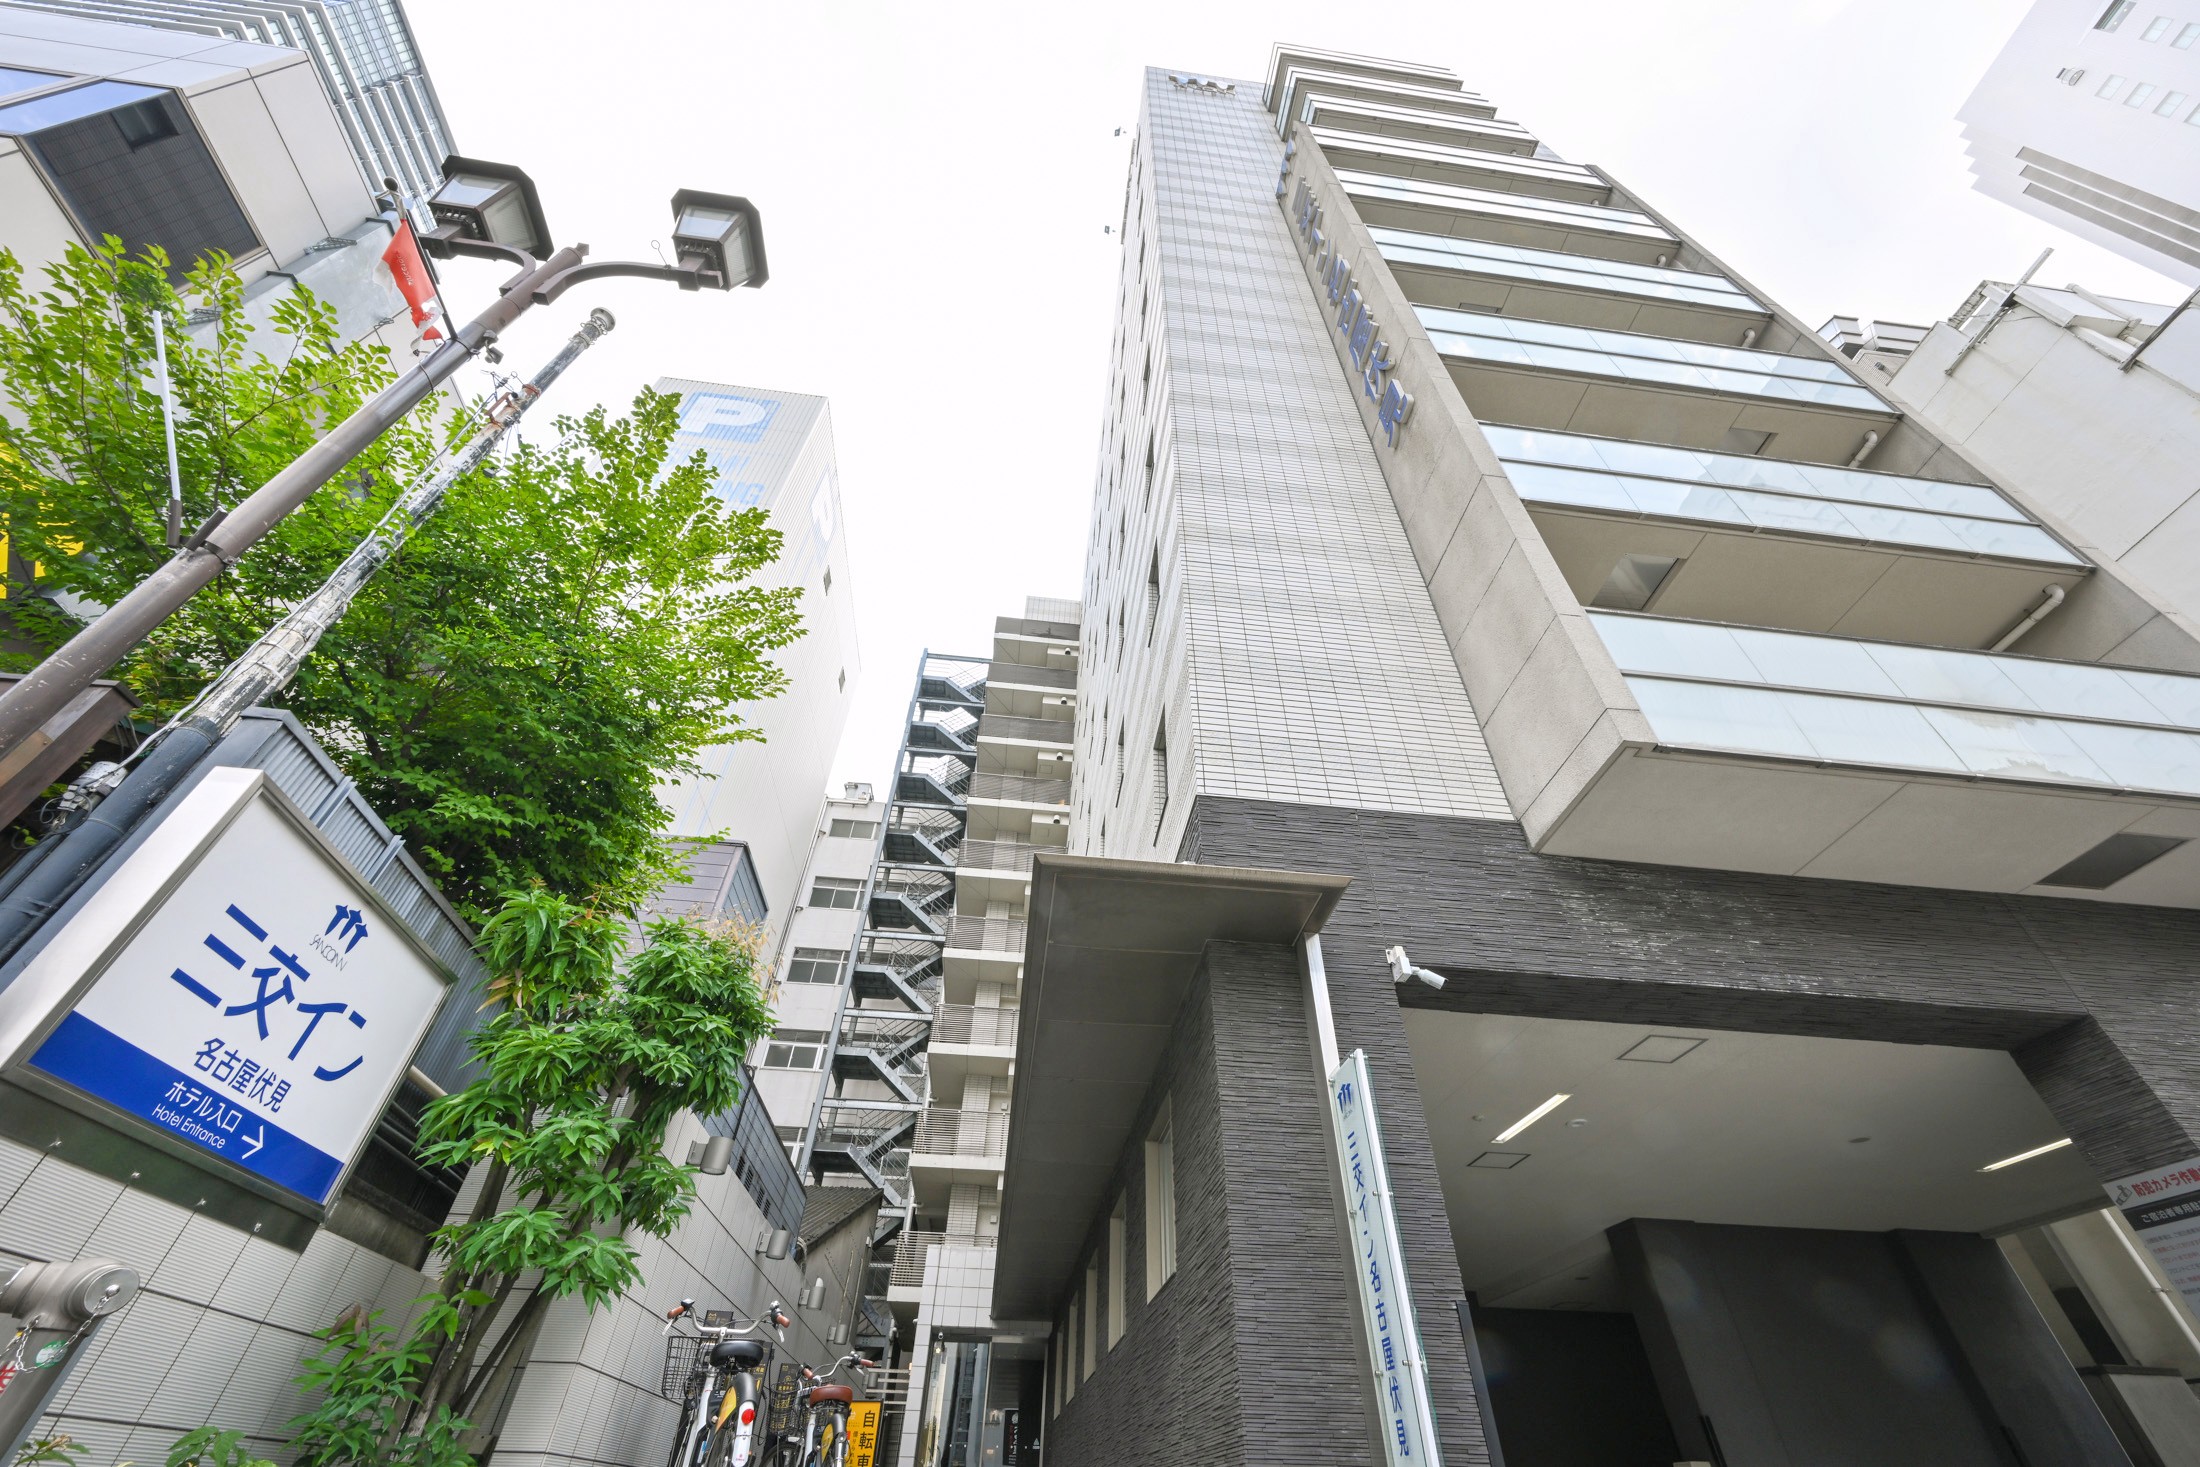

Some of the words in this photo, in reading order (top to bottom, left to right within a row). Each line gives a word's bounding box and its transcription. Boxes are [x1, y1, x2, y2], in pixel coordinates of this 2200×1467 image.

[170, 903, 367, 1081] 三交イン
[194, 1037, 292, 1113] 名古屋伏見
[151, 1103, 185, 1128] Hotel
[180, 1118, 226, 1149] Entrance
[165, 1081, 243, 1133] ホテル入口
[2131, 1166, 2200, 1198] 防犯カメラ作動
[2141, 1200, 2200, 1223] ご宿泊者専用駐
[1347, 1131, 1409, 1457] 三交イン名古屋伏見
[857, 1410, 875, 1467] 自転車
